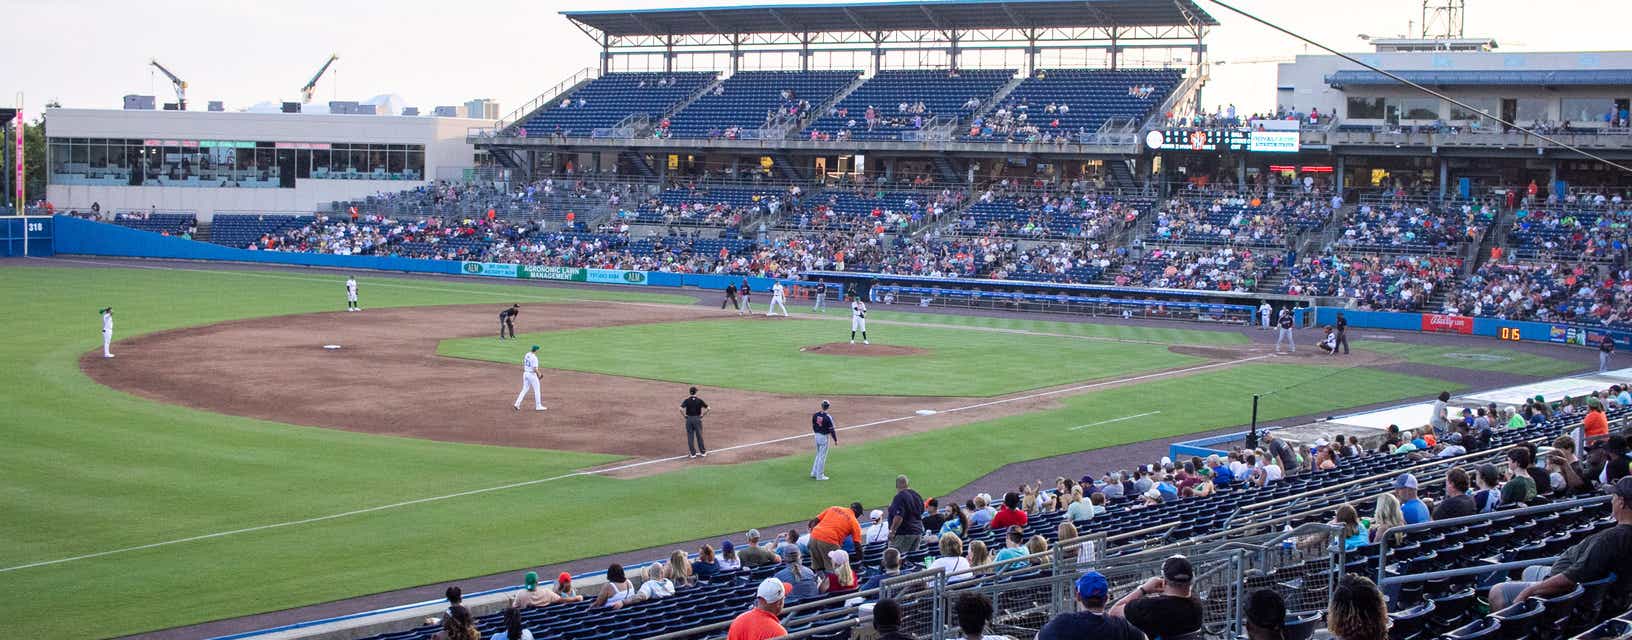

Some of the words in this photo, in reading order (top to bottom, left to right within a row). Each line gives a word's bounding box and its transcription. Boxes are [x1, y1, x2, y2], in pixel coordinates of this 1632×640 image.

[524, 264, 561, 274] AGRONOMIC
[562, 267, 580, 275] LAWN
[530, 271, 572, 281] MANAGEMENT
